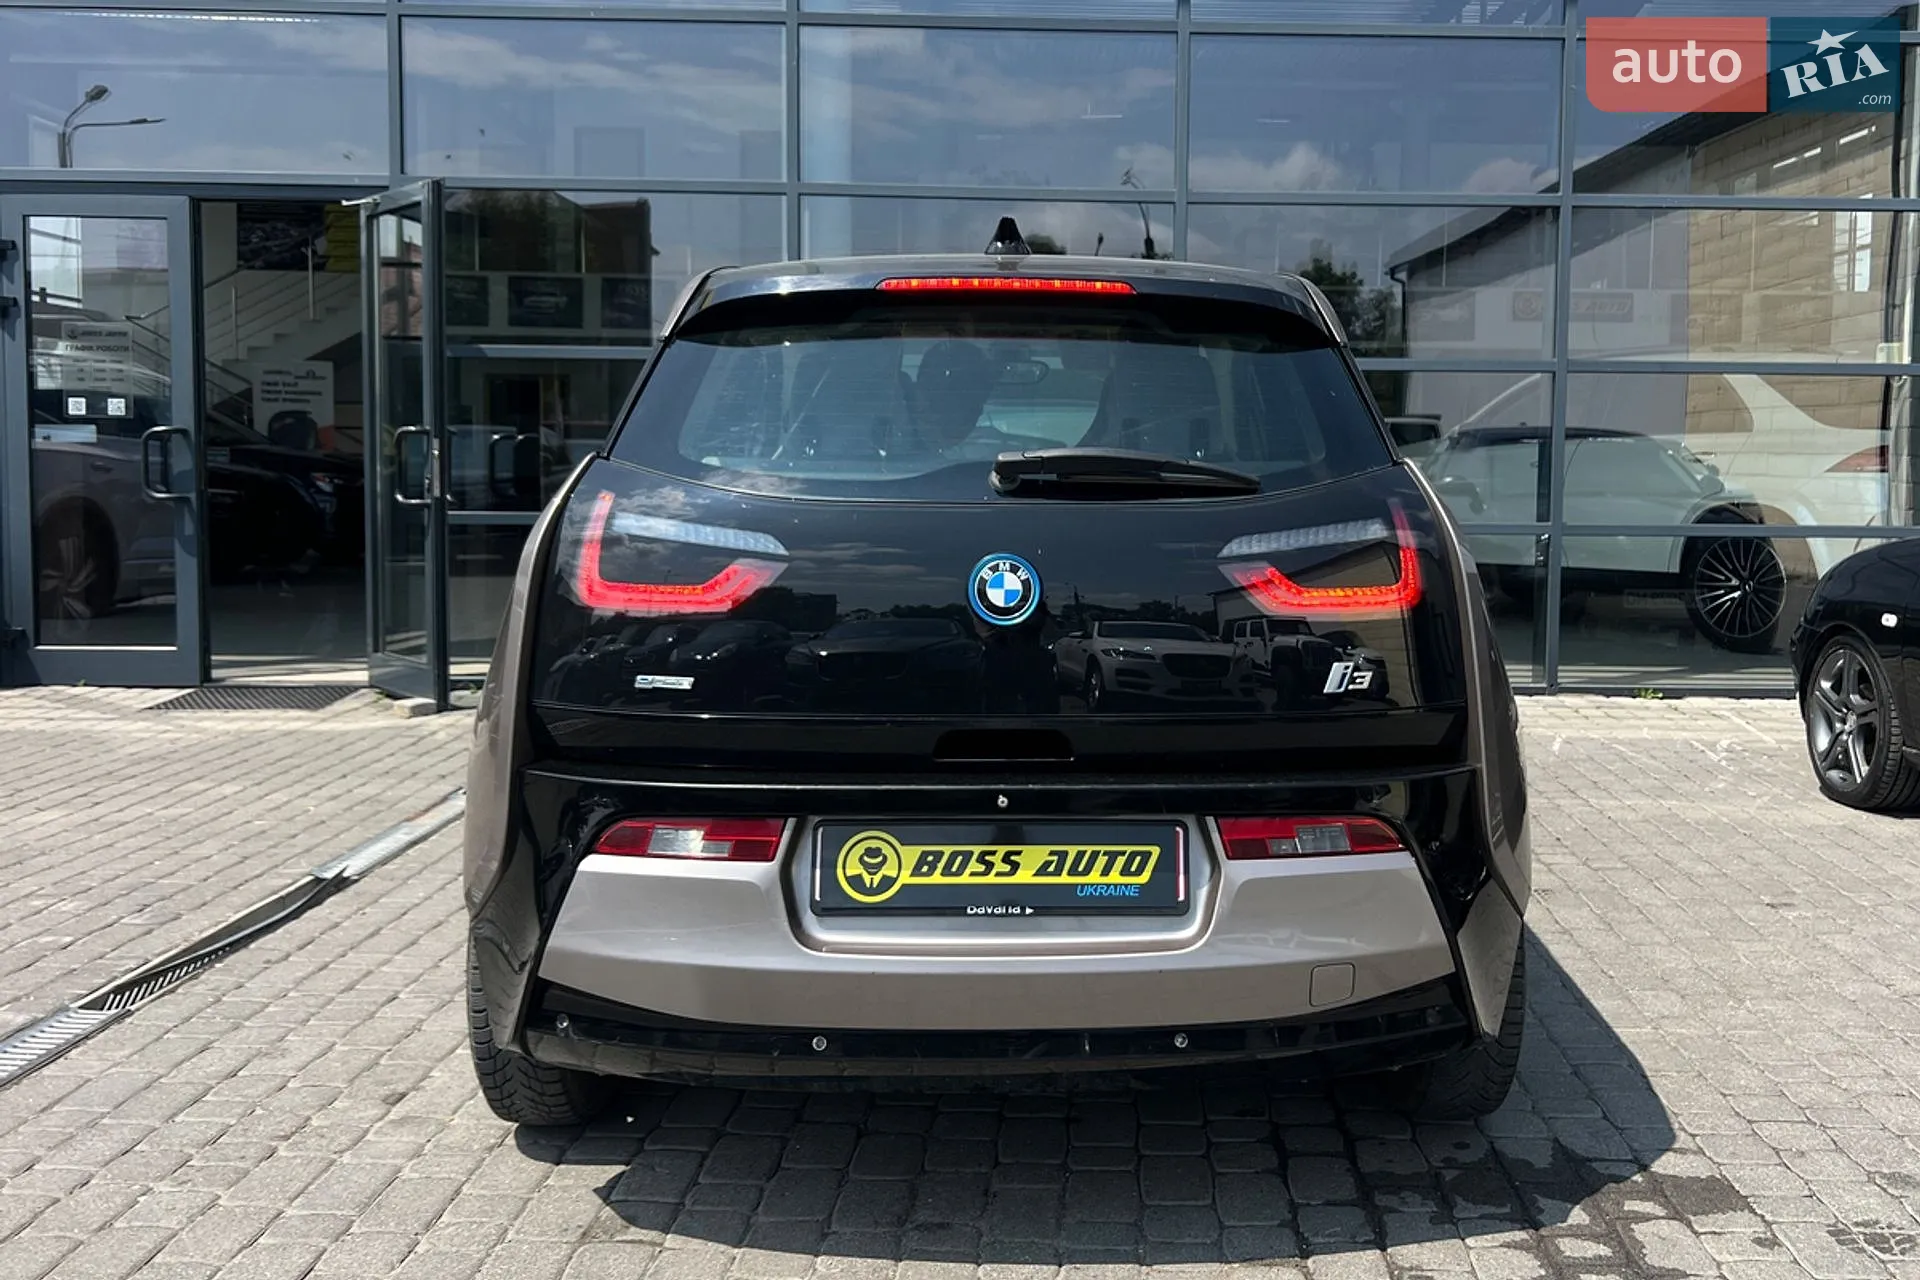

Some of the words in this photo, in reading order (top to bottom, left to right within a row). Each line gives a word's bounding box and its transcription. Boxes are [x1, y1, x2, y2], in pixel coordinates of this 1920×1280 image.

[980, 561, 1030, 581] BMW
[1323, 662, 1373, 694] i3
[909, 849, 1025, 878] BOSS
[1032, 849, 1154, 878] AUTO
[1076, 884, 1140, 897] UKRAINE
